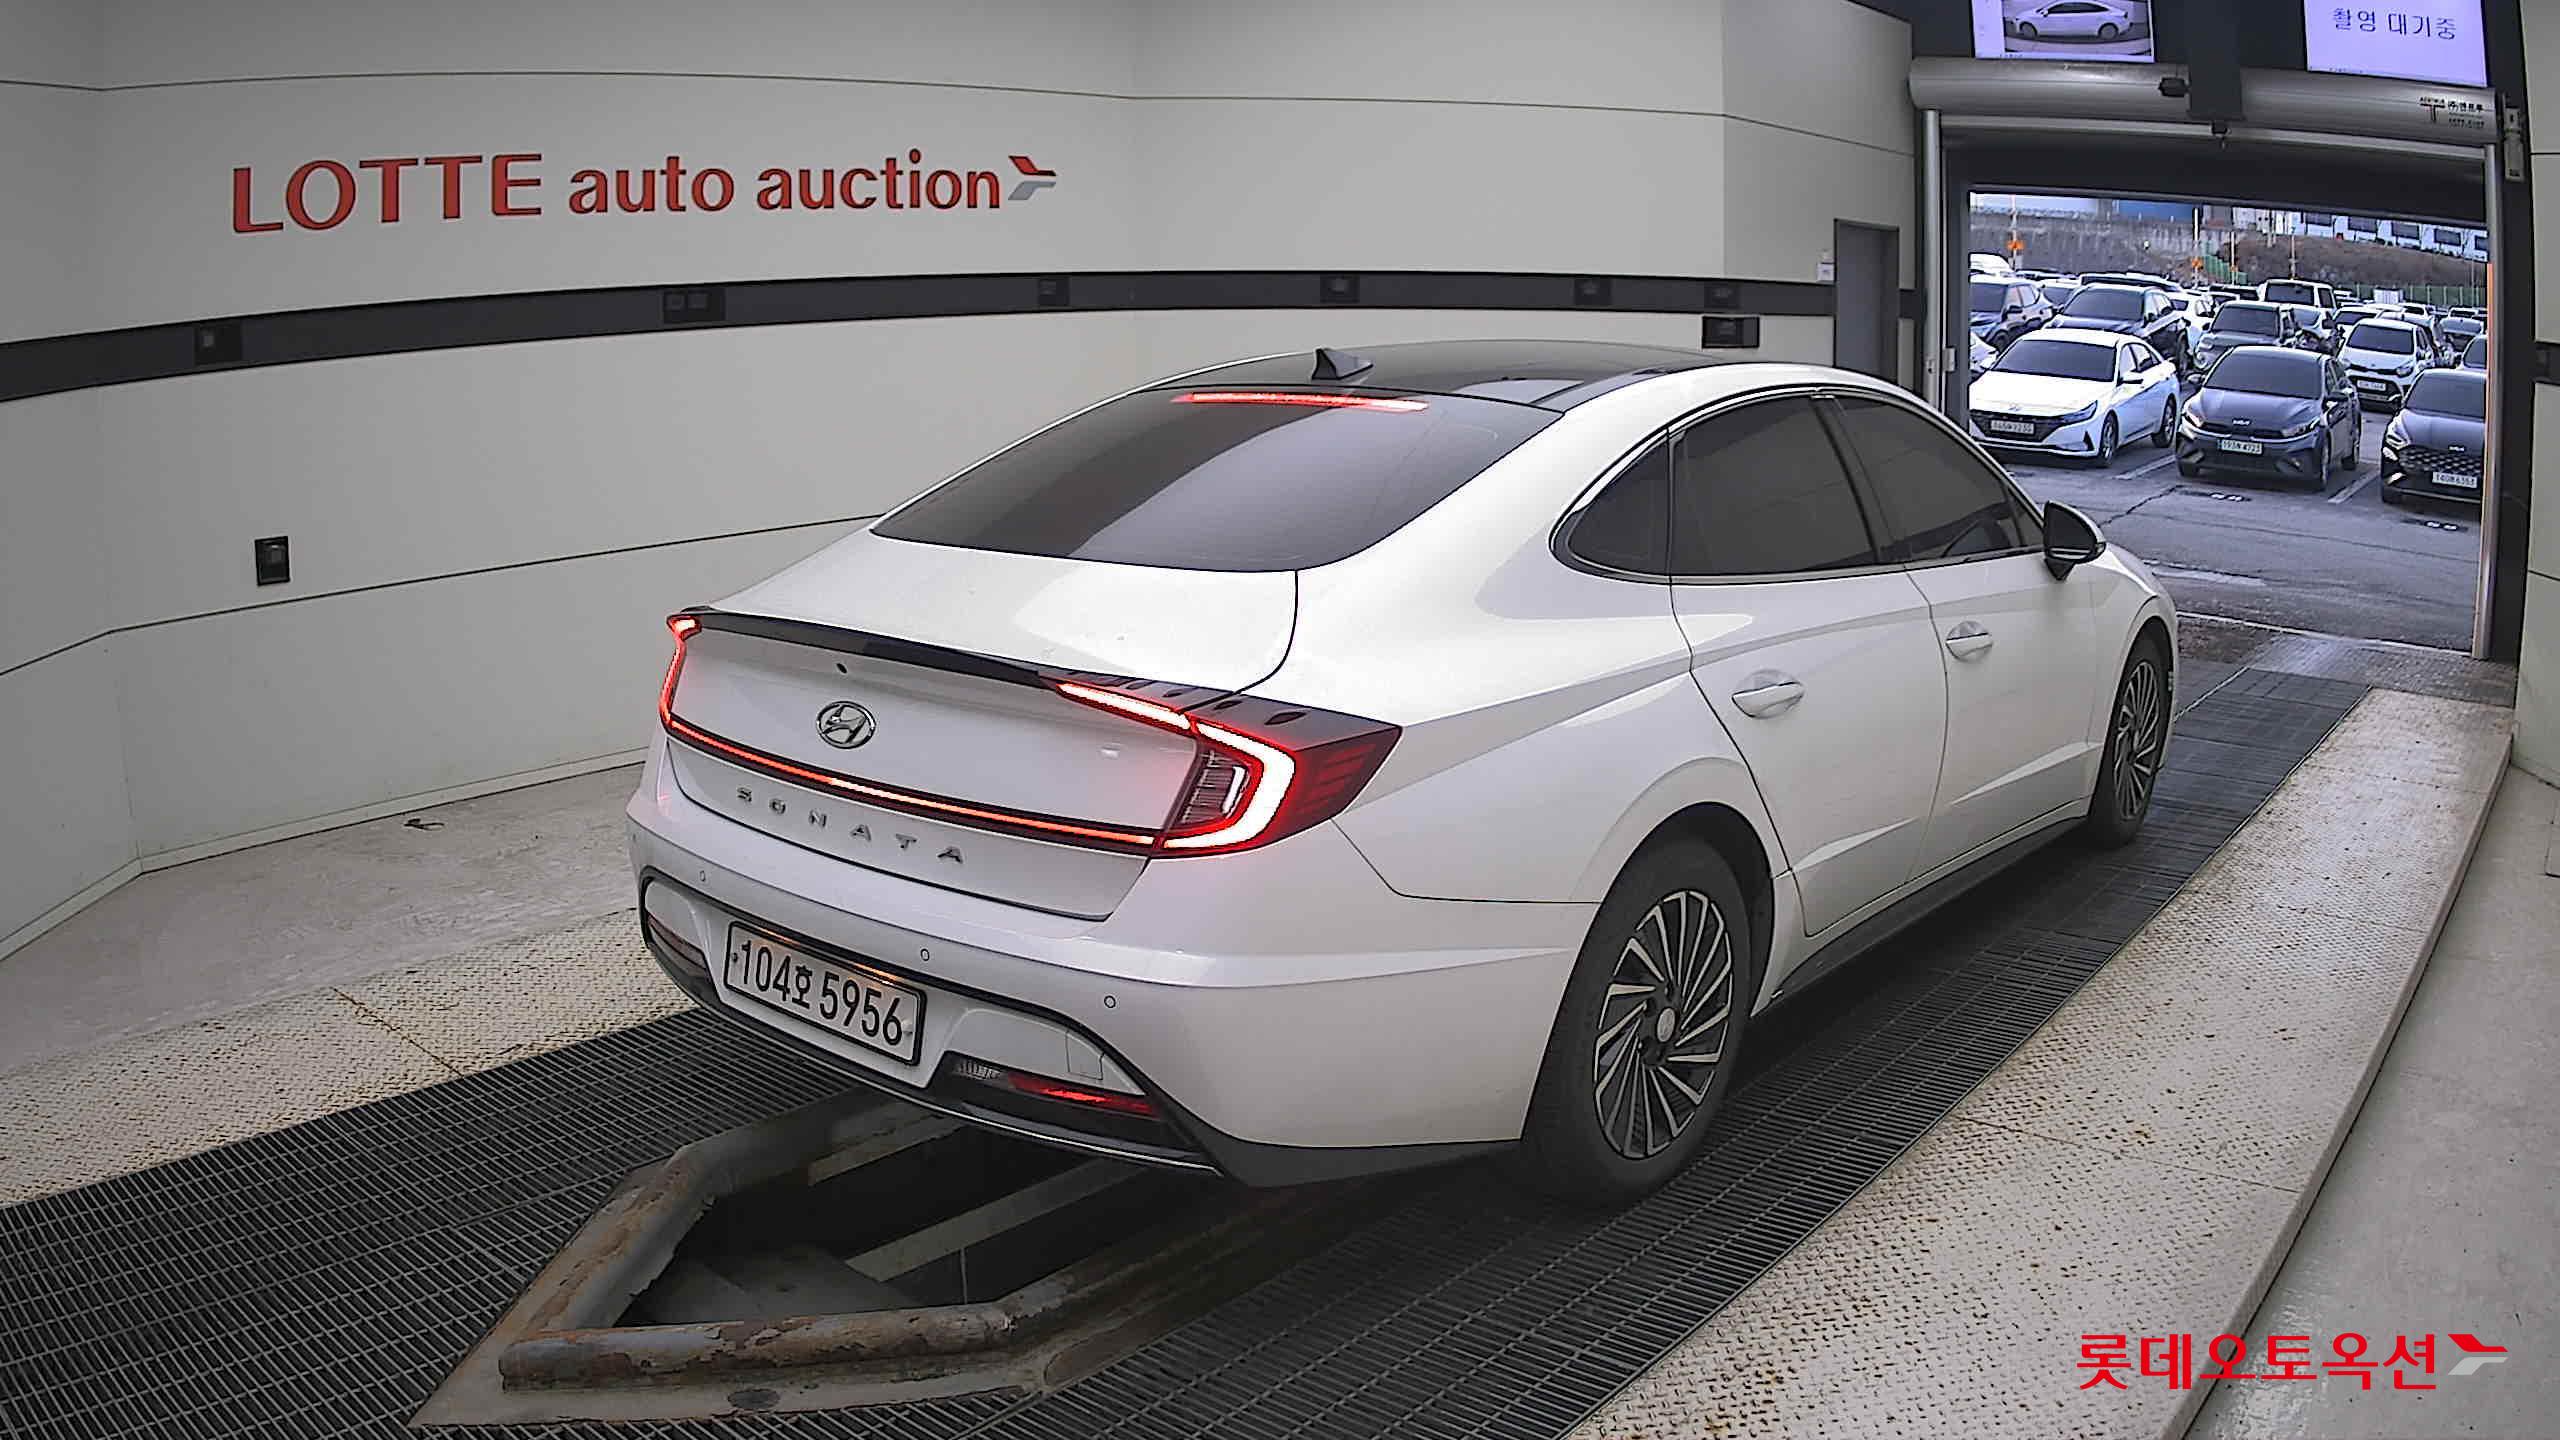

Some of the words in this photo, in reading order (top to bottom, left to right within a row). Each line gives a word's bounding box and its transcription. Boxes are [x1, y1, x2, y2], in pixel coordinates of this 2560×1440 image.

[2388, 13, 2457, 40] 대기중
[232, 153, 543, 234] LOTTE
[568, 156, 736, 214] auto
[755, 148, 1001, 211] auction
[736, 786, 964, 865] SONATA
